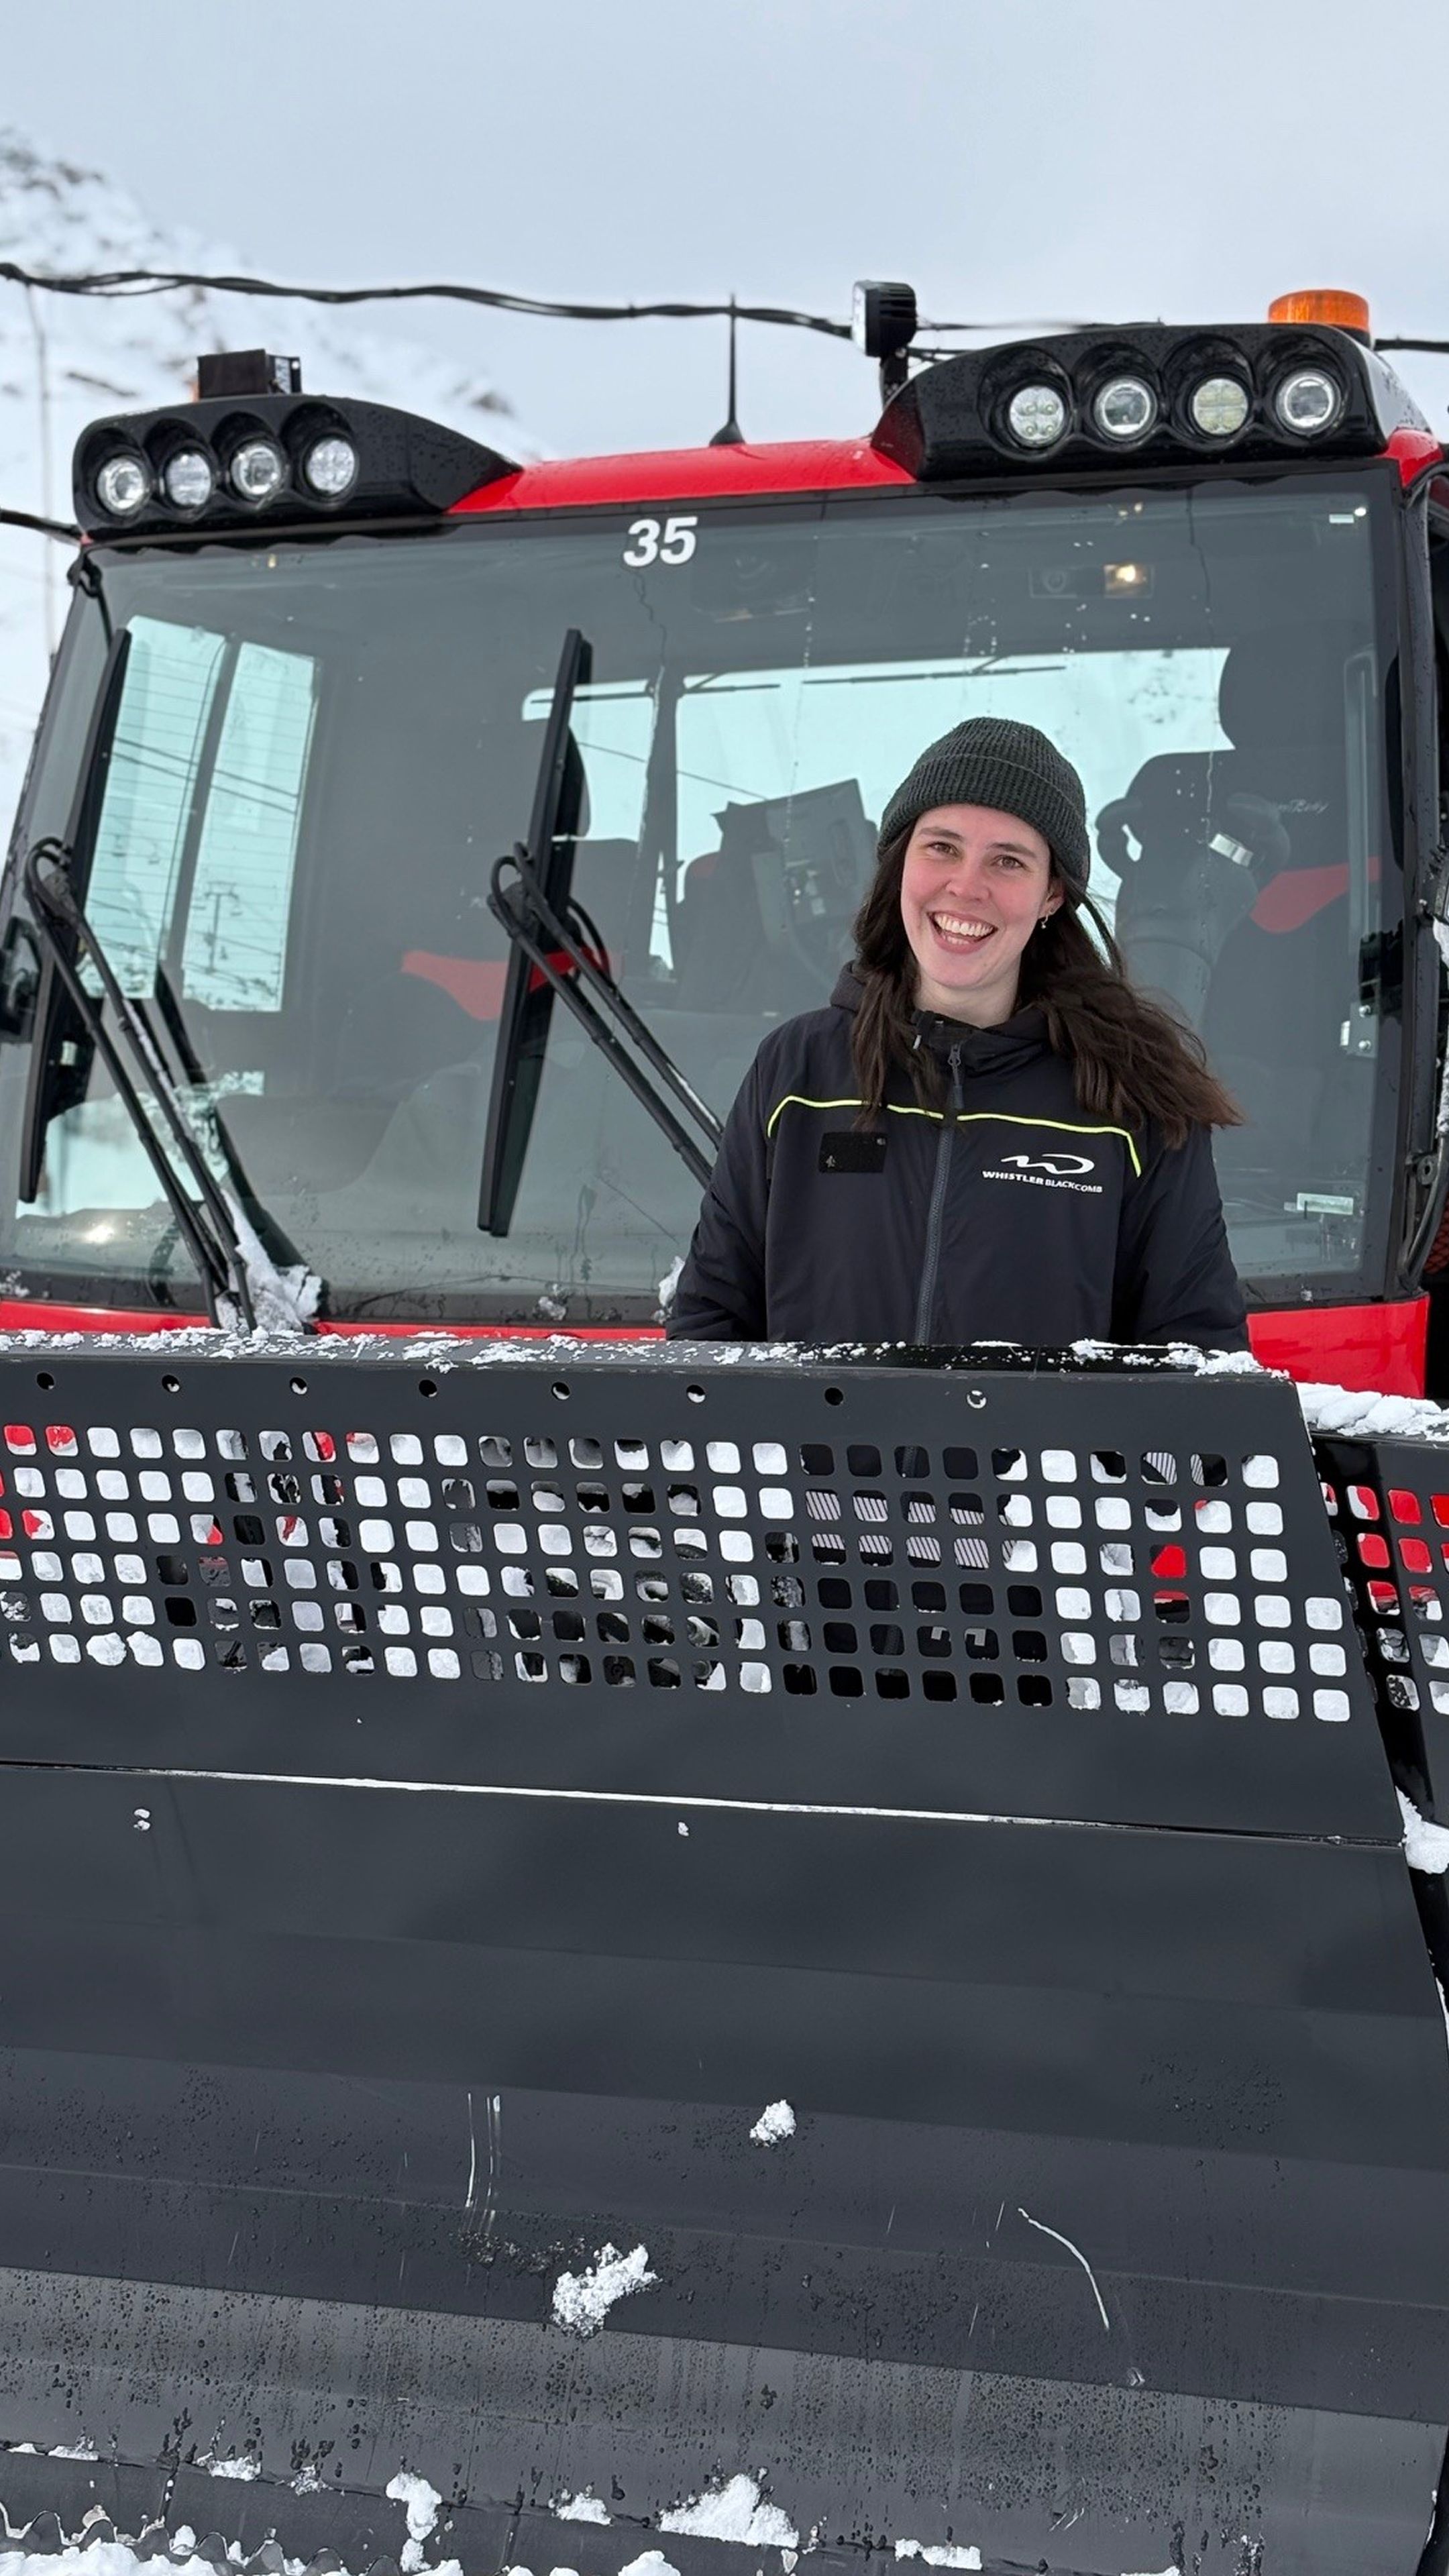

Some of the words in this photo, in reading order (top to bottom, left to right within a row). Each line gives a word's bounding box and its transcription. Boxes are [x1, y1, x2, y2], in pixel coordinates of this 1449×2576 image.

[623, 516, 698, 567] 35
[982, 1171, 1044, 1185] WHISTLER
[1045, 1179, 1103, 1193] BLACKCOMB
